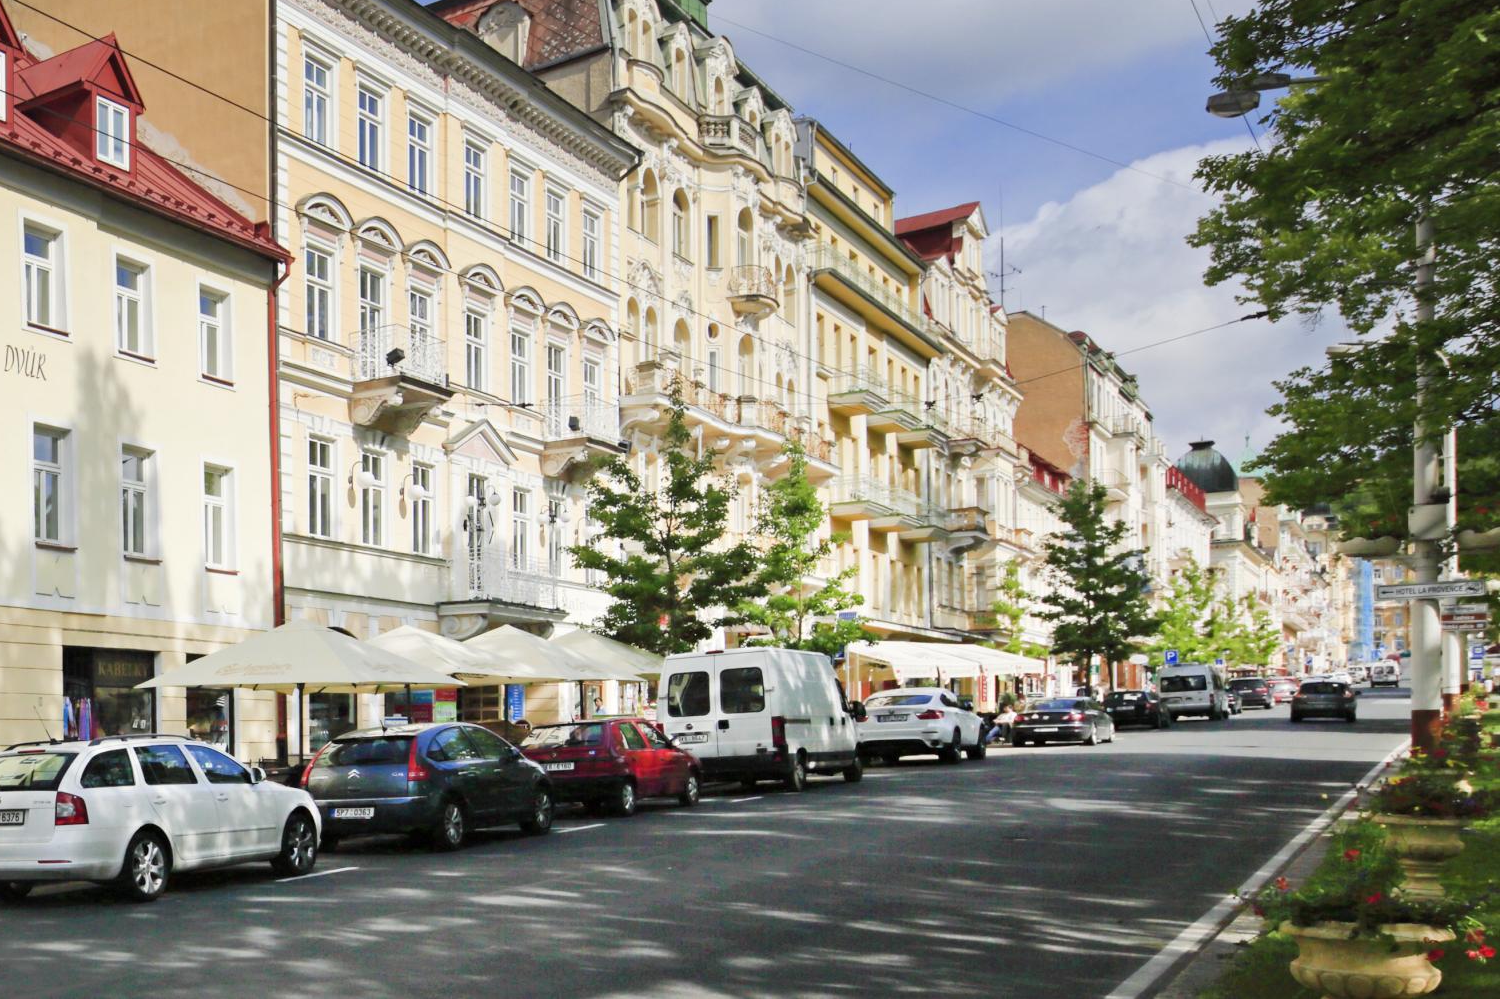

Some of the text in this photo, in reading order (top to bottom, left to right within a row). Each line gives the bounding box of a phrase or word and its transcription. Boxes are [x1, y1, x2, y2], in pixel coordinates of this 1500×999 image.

[4, 344, 47, 382] DVŮR
[1396, 585, 1463, 595] HOTEL LA PROVENCE
[1166, 651, 1176, 661] P
